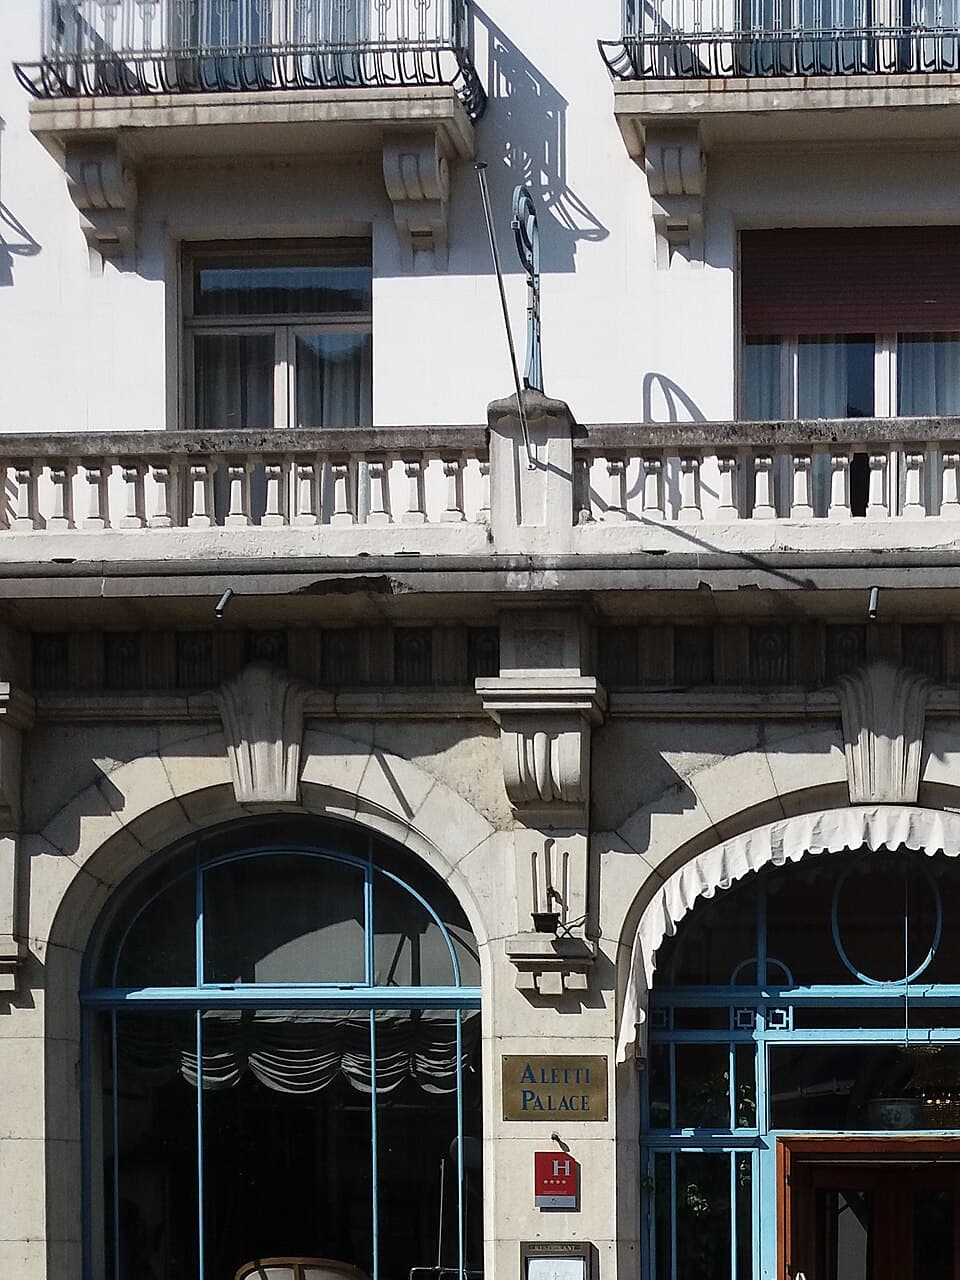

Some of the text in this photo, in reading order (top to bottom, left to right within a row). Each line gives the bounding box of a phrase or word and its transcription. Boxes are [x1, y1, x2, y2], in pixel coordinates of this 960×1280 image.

[520, 1062, 590, 1084] ALETTI
[521, 1089, 590, 1111] PALACE
[553, 1159, 570, 1177] H
